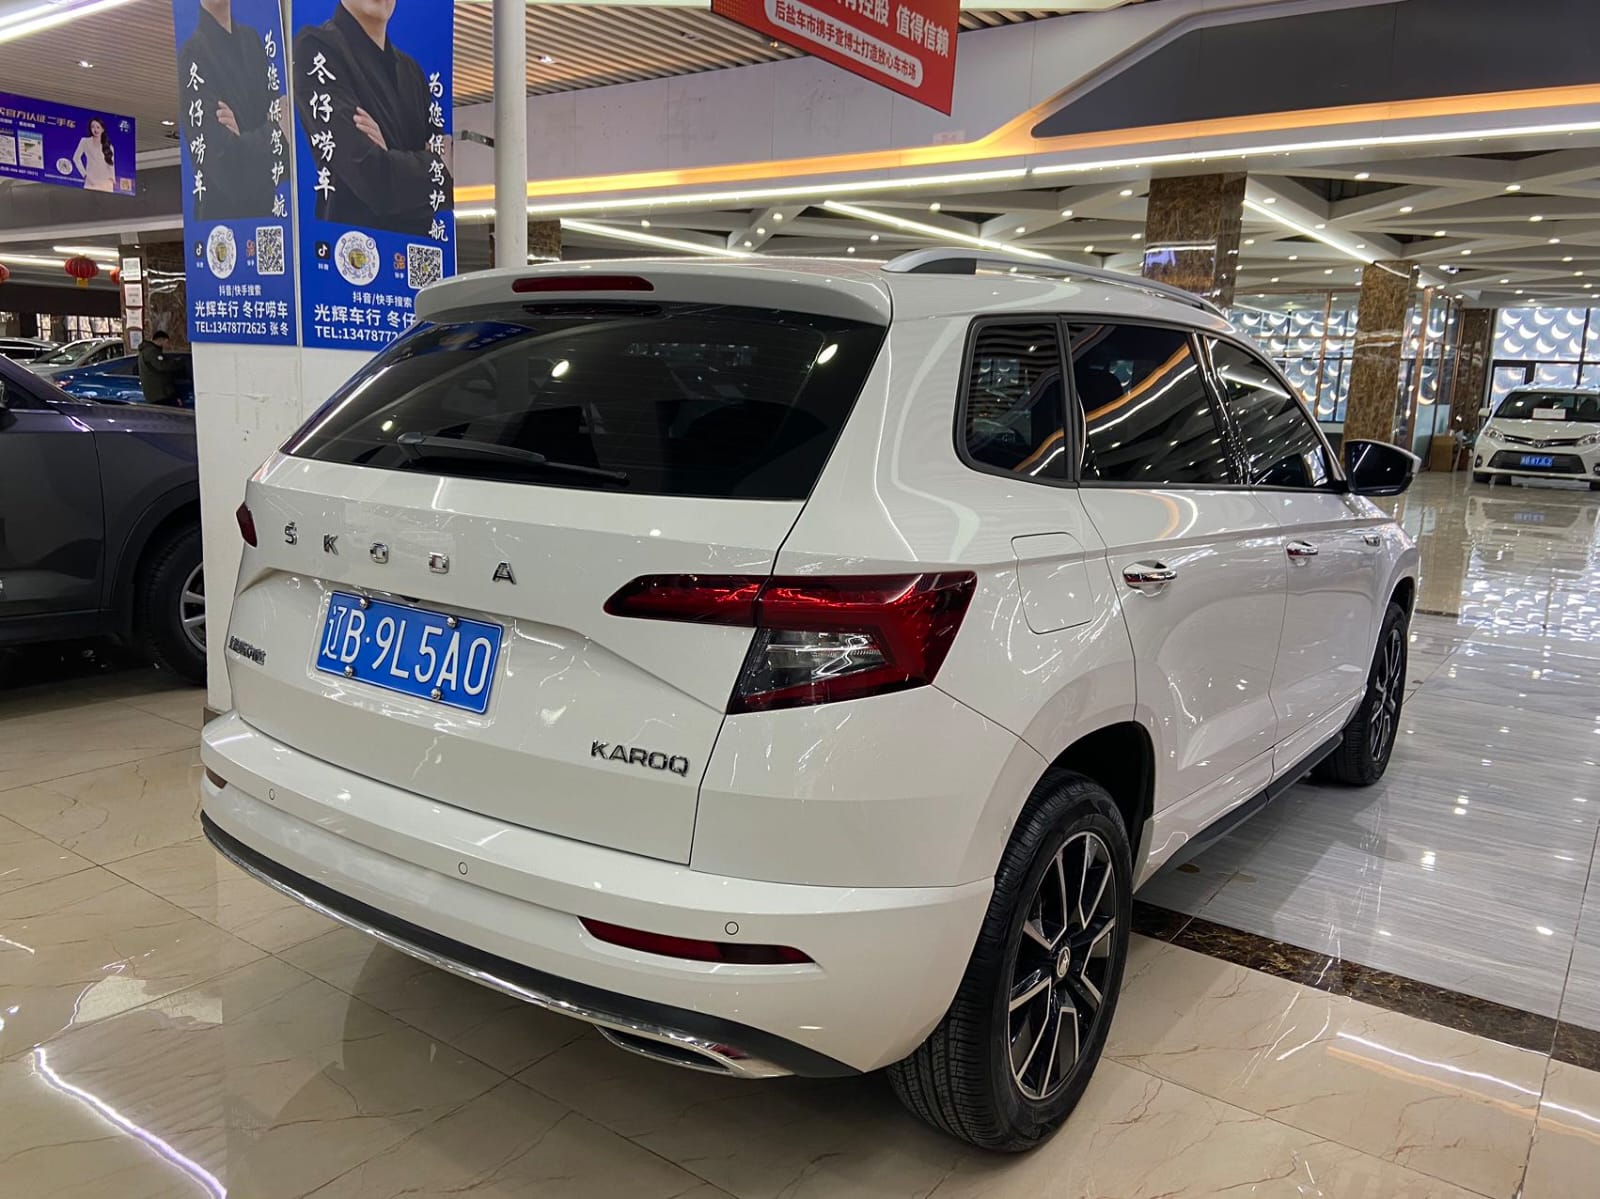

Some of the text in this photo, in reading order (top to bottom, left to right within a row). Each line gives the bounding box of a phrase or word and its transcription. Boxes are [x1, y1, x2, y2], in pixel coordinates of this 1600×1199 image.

[897, 4, 949, 58] 值得信赖
[186, 62, 208, 201] 冬仔唠车
[264, 30, 288, 218] 为您保驾护航
[306, 52, 337, 201] 冬仔唠车
[428, 72, 449, 242] 为您保驾护航
[195, 300, 288, 319] 光辉车行 冬仔唠车
[314, 304, 382, 326] 光辉车行
[352, 291, 413, 308] 抖音/快手搜索
[195, 321, 267, 334] TEL:13478772625
[590, 739, 690, 777] KAROQ
